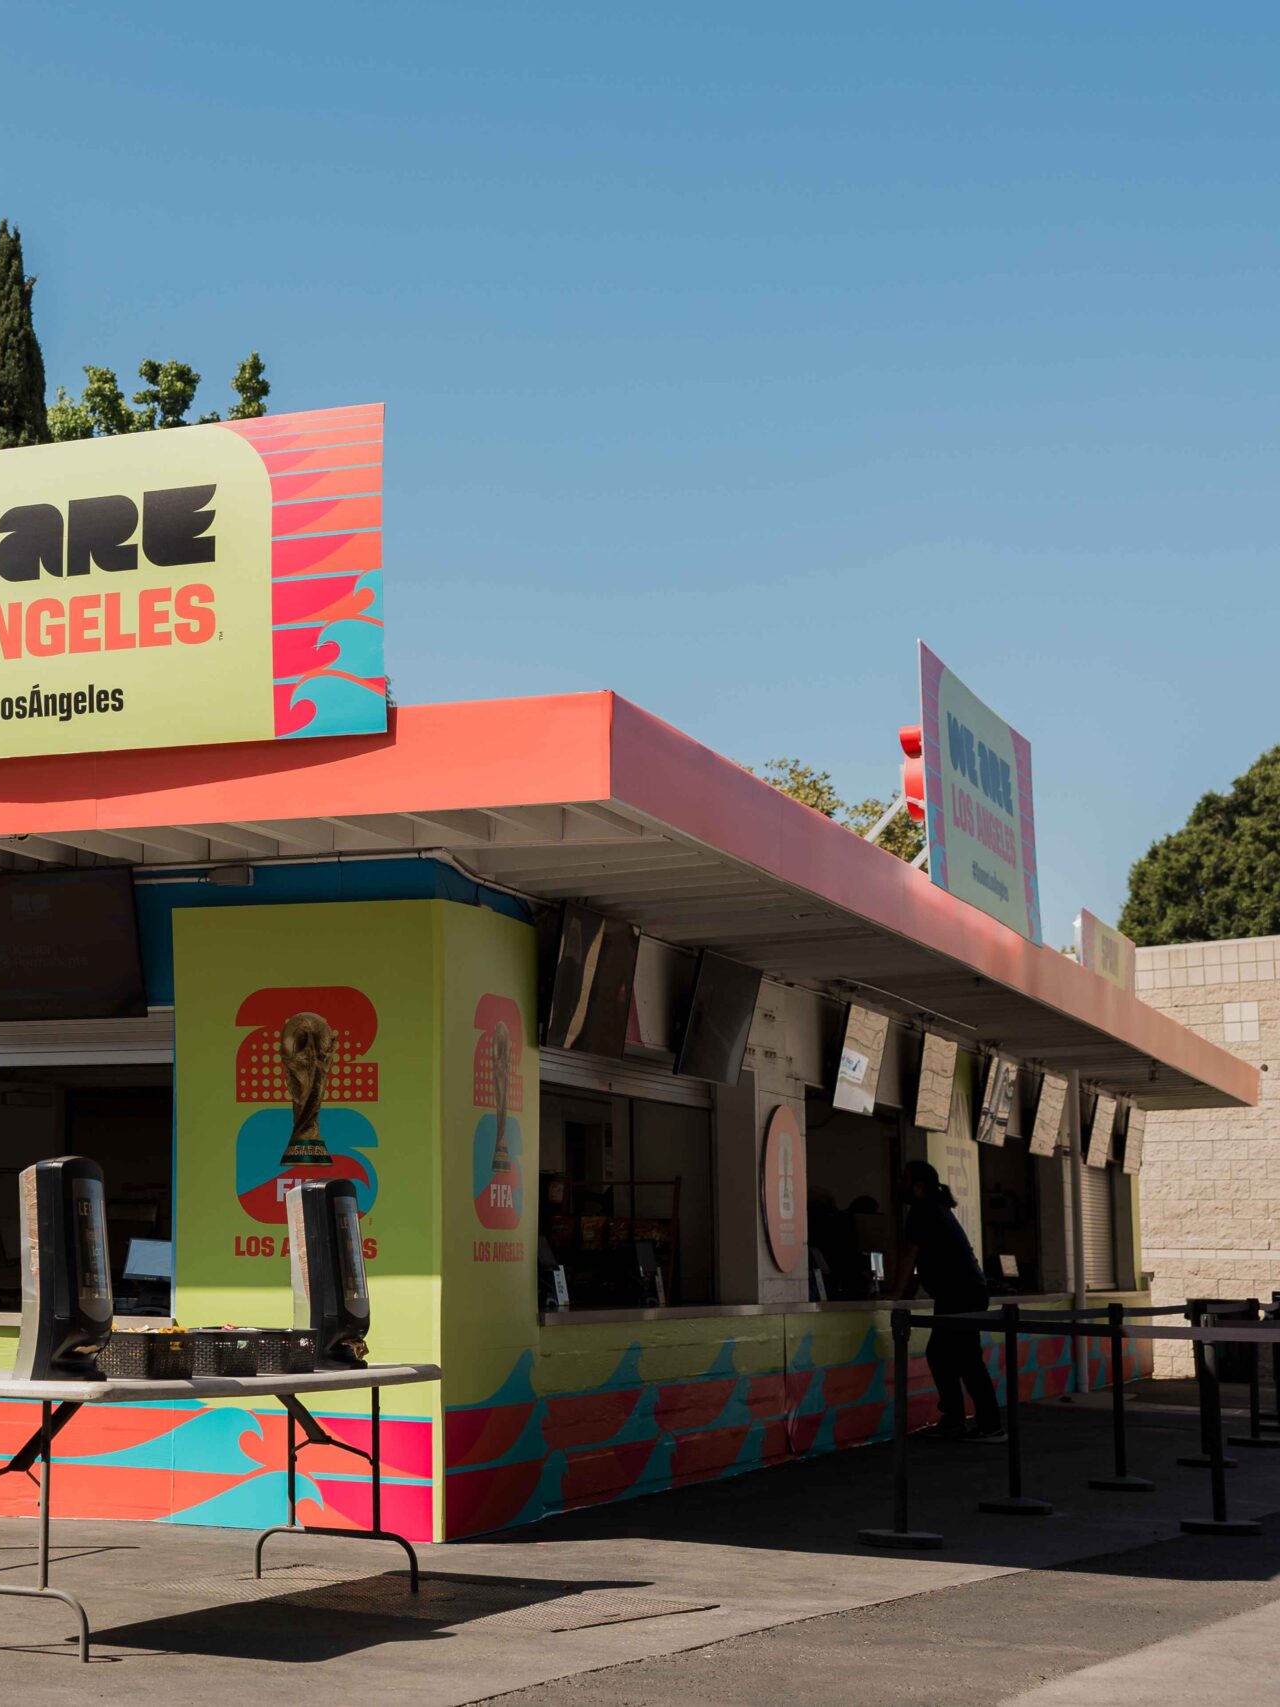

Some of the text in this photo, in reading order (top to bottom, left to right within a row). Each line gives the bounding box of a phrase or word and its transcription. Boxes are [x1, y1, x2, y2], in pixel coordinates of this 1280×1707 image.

[947, 711, 979, 788] WE
[951, 783, 1016, 870] LOS ANGELES
[489, 1183, 514, 1209] FIFA
[234, 1235, 275, 1258] LOS
[472, 1241, 525, 1264] LOS ANGELES
